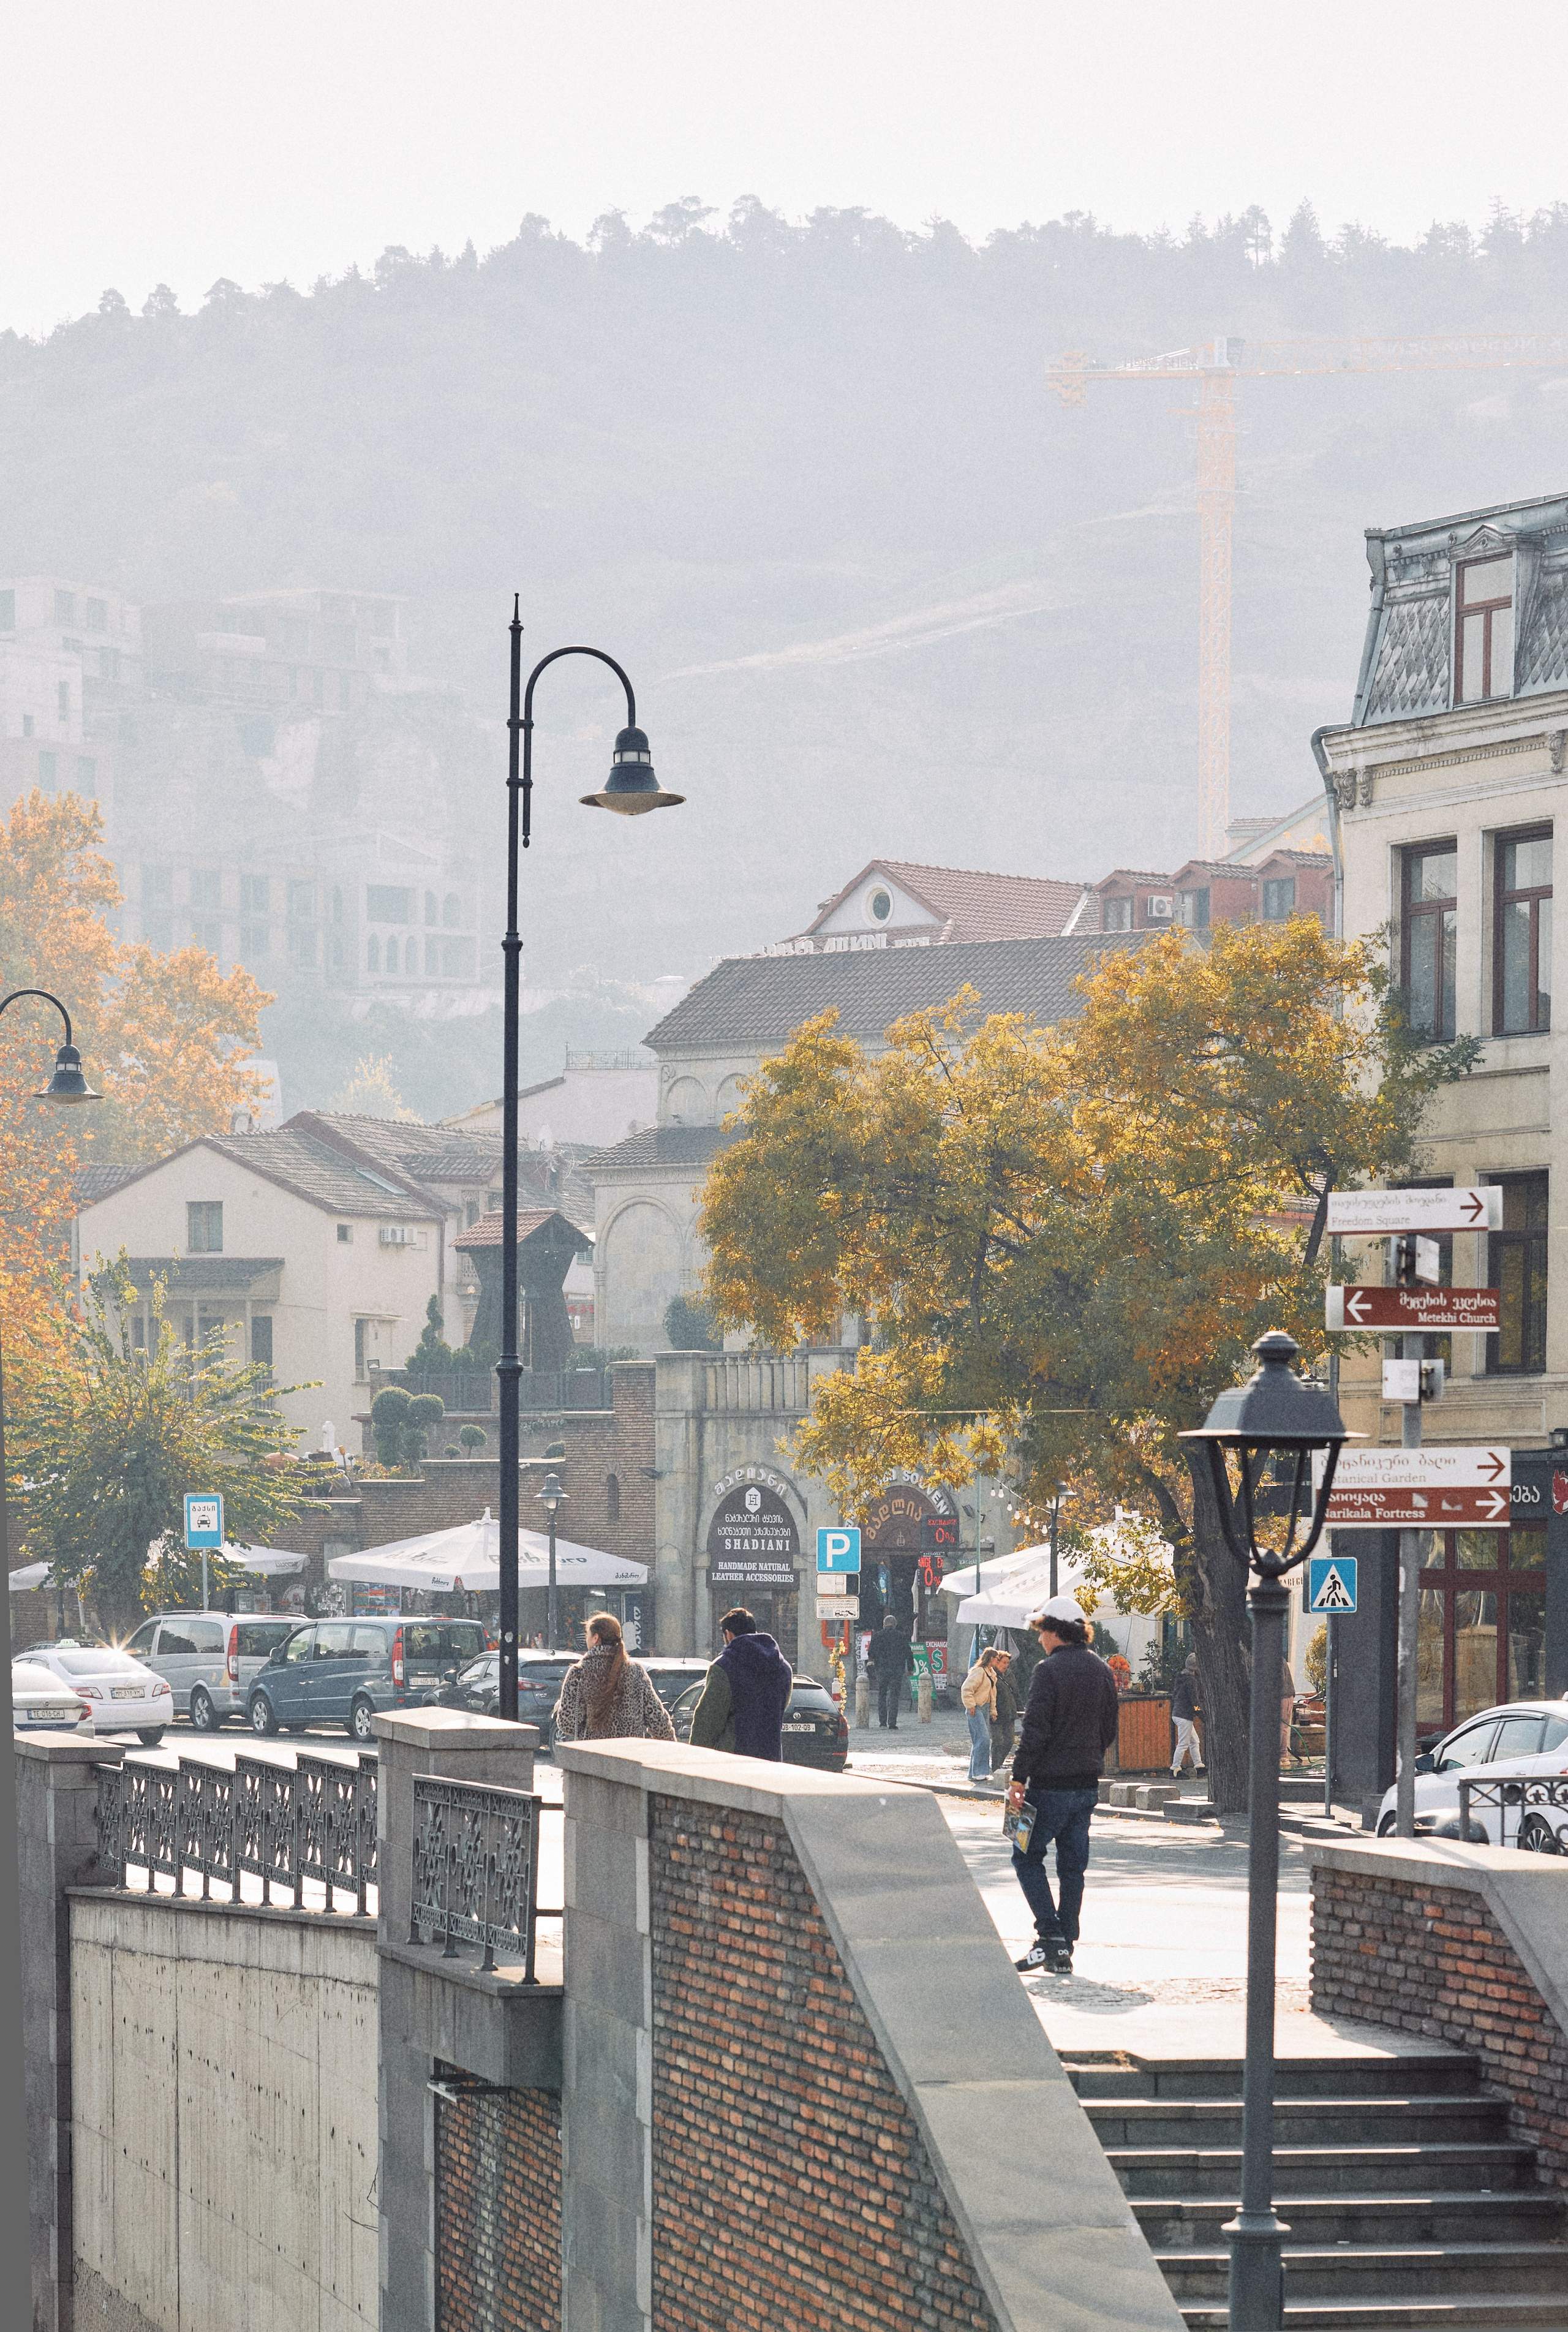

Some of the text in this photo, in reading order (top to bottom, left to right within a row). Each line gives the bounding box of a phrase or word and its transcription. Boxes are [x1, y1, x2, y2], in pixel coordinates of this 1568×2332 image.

[1332, 1216, 1411, 1227] Freedom Square
[1400, 1291, 1496, 1310] მეტეხის ეკლესია
[1418, 1311, 1496, 1323] Metekhi Church
[1419, 1454, 1456, 1469] ბაღი
[1323, 1473, 1426, 1484] otanical Garden
[1509, 1485, 1540, 1503] ება
[1376, 1507, 1425, 1519] Fortress
[935, 1528, 955, 1543] 0%
[725, 1539, 790, 1551] SHADIANI
[826, 1533, 850, 1568] P
[718, 1562, 790, 1571] HANDMADE NATURAL
[745, 1573, 794, 1582] ACCESSORIES
